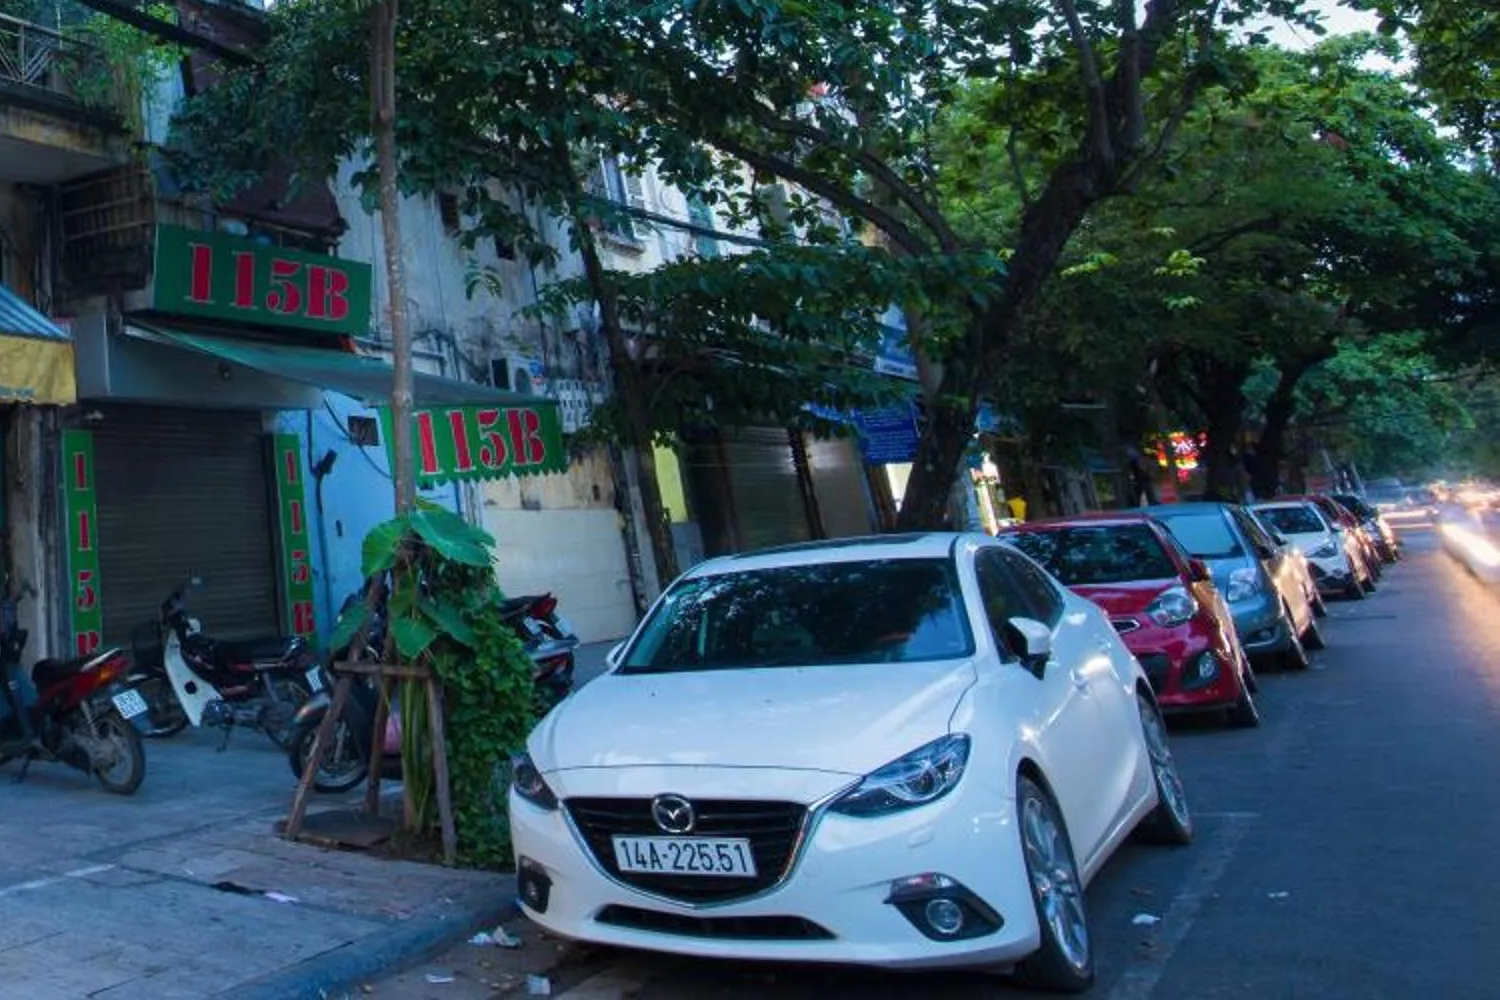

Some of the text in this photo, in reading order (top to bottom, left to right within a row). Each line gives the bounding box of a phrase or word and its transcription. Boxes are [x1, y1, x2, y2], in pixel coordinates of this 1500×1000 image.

[185, 242, 349, 320] 115B
[412, 408, 546, 476] 115B
[284, 450, 316, 635] 115B
[619, 840, 747, 873] 14A-225.51
